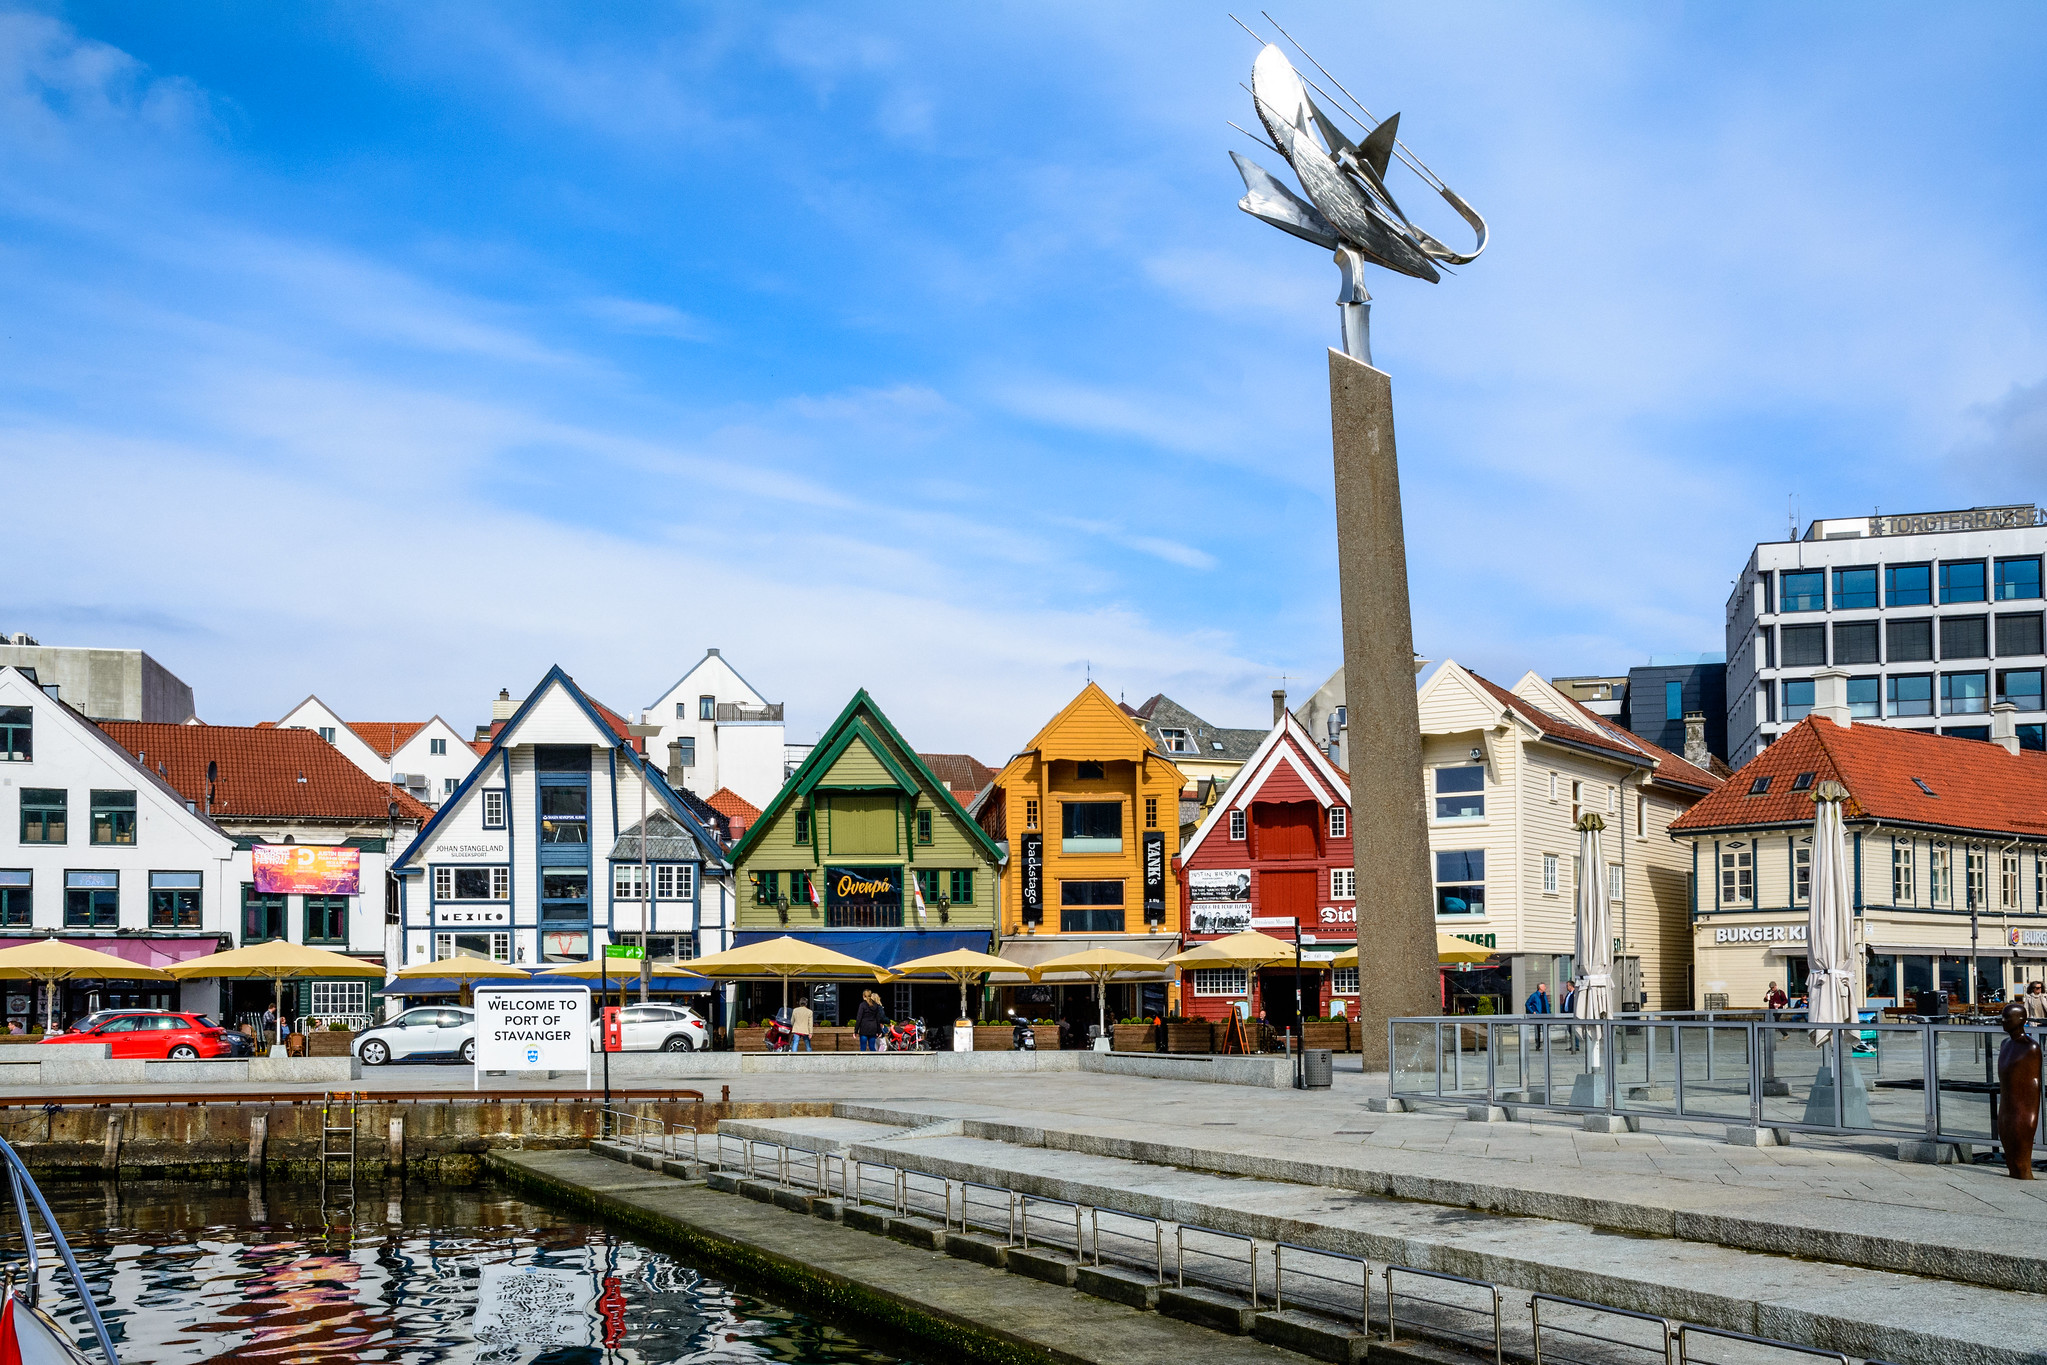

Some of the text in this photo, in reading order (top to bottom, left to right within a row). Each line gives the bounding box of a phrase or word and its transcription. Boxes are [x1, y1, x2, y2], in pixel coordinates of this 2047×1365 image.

[459, 844, 504, 852] STANGELAND
[1024, 841, 1042, 904] backstage
[1214, 870, 1238, 878] BIEBER
[837, 875, 891, 899] Ovenpå
[441, 913, 503, 921] MEXIKO
[1716, 926, 1785, 942] BURGER
[488, 1000, 577, 1010] WELCOME TO
[505, 1015, 561, 1026] PORT OF
[494, 1030, 571, 1041] STAVANGER
